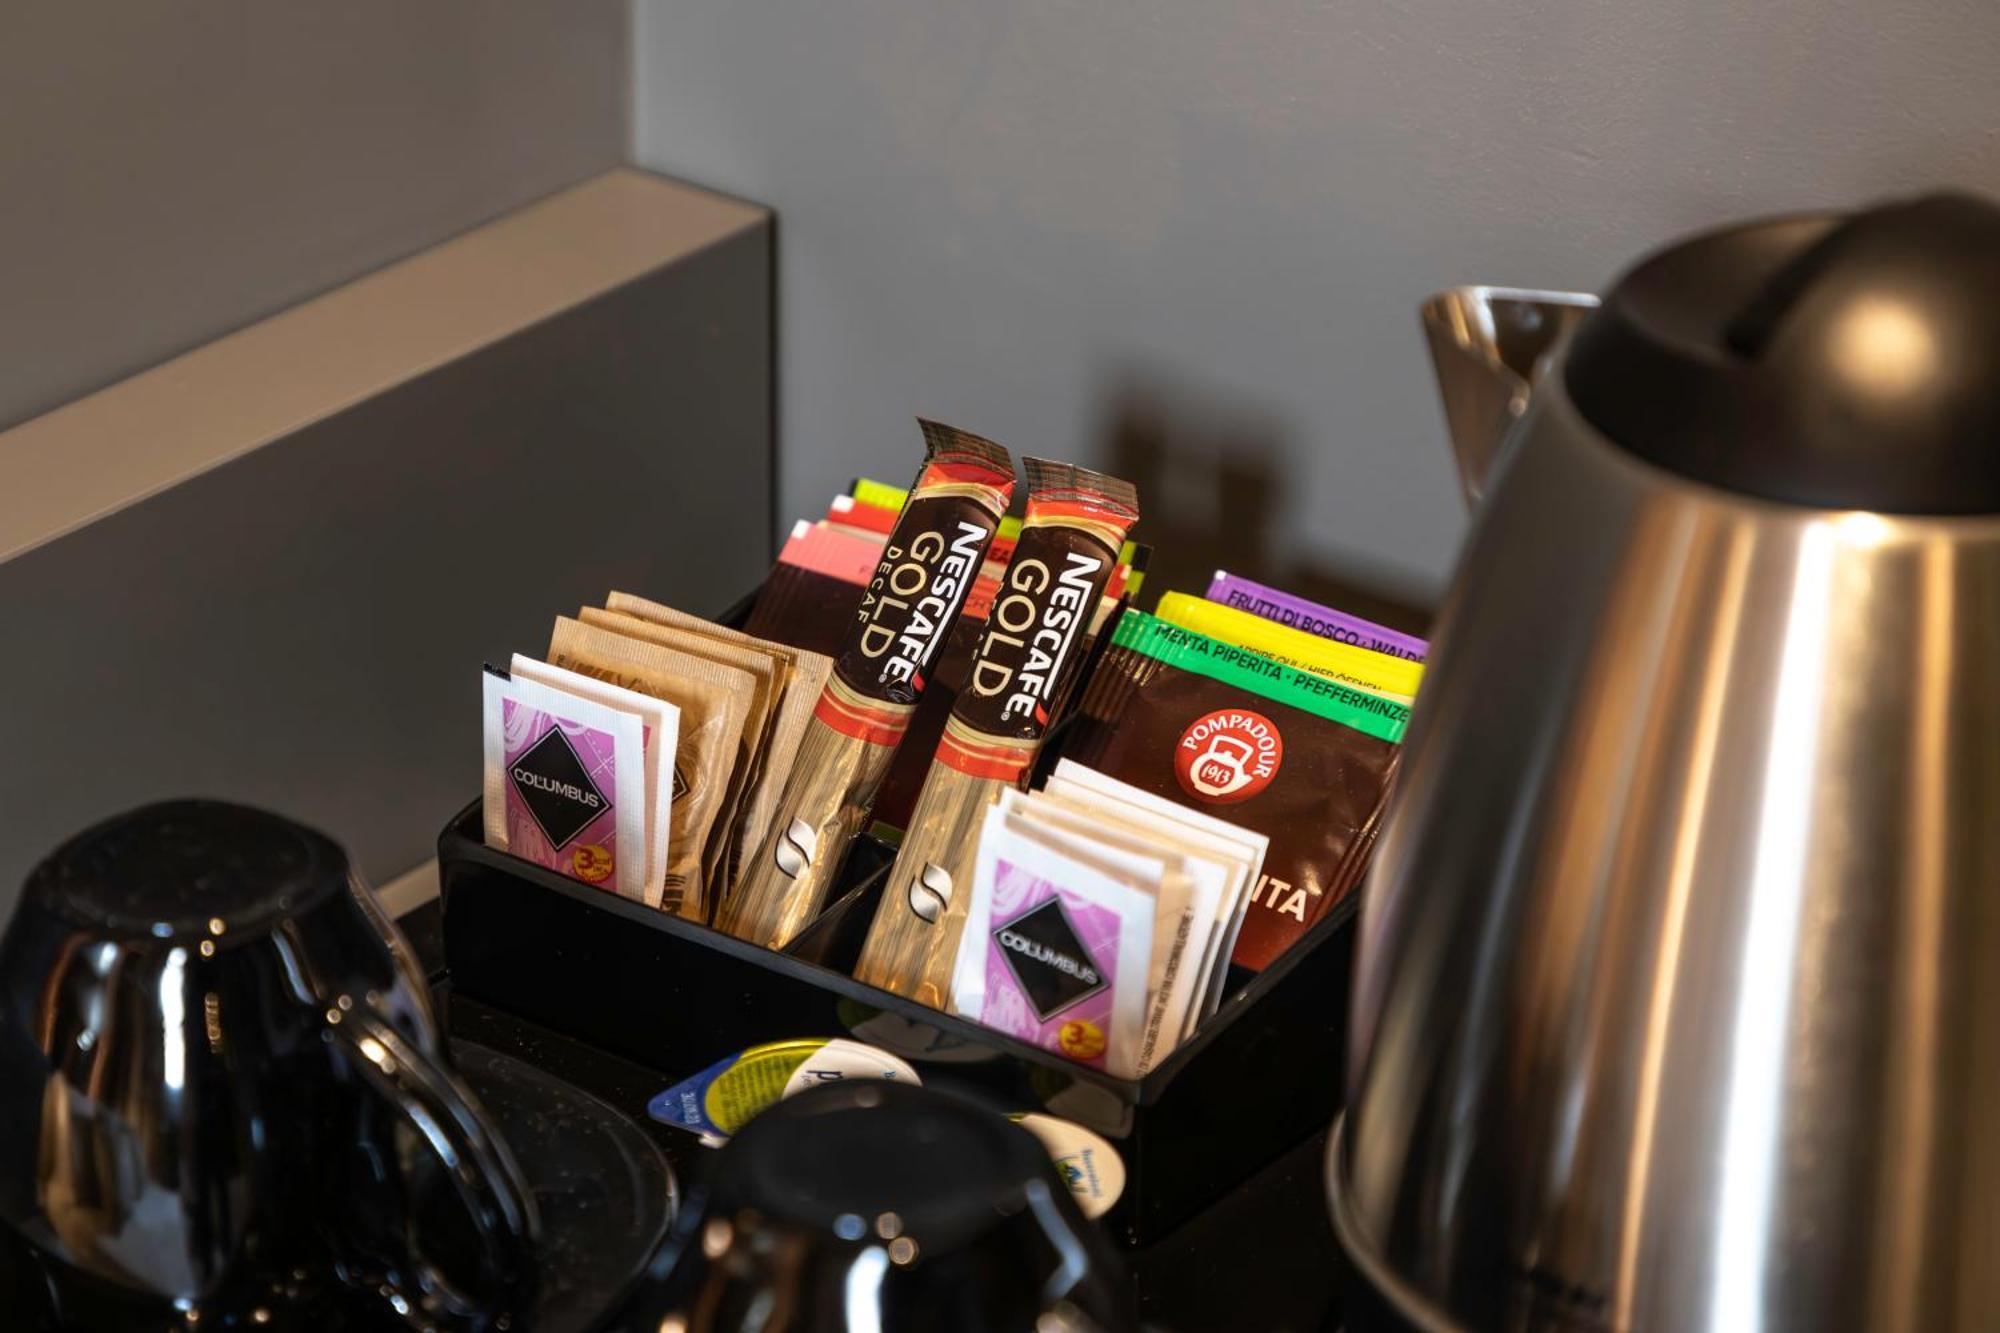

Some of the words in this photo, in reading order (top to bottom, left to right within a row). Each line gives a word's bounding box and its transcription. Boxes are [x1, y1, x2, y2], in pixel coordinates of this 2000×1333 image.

[857, 545, 904, 623] DECAF
[860, 531, 945, 659] GOLD
[973, 558, 1050, 697] GOLD
[1227, 590, 1281, 619] FRUTTI
[1282, 609, 1298, 627] DI
[1300, 616, 1360, 646] BOSCO
[1155, 625, 1210, 656] MENTA
[1212, 644, 1283, 681] PIPERITA
[1294, 674, 1411, 723] PFEFFERMINZE
[1182, 714, 1277, 778] POMPADOUR
[1201, 764, 1231, 784] 1913
[513, 767, 599, 808] COLUMBUS
[1251, 874, 1307, 922] ITA
[1000, 930, 1098, 985] COLUMBUS
